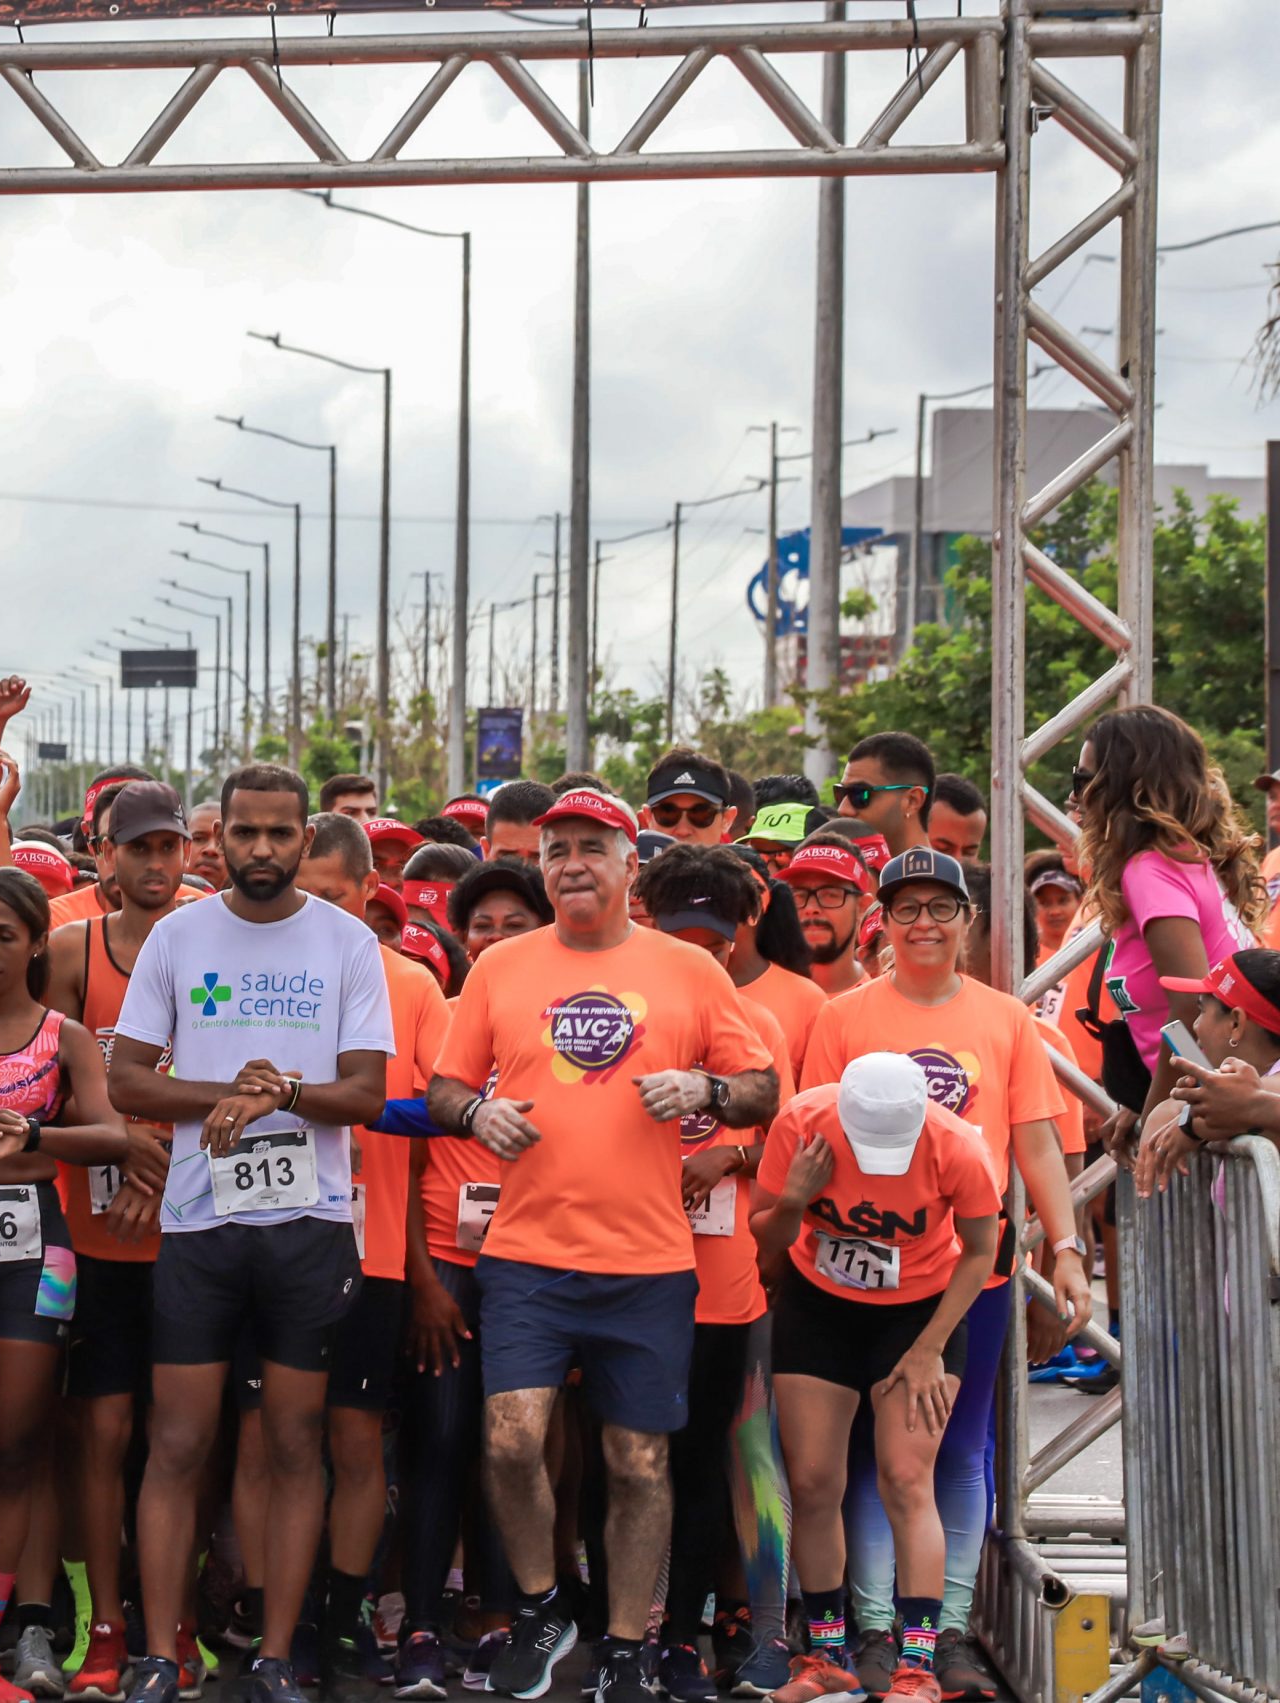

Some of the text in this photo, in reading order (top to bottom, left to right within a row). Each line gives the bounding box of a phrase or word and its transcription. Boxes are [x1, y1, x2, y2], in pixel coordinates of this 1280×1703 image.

[240, 970, 323, 997] saúde
[239, 996, 321, 1018] center
[199, 1019, 229, 1028] Centro
[230, 1017, 263, 1027] Médico
[264, 1018, 276, 1028] do
[277, 1018, 320, 1032] Shopping
[233, 1156, 295, 1191] 813
[828, 1239, 885, 1288] 1111
